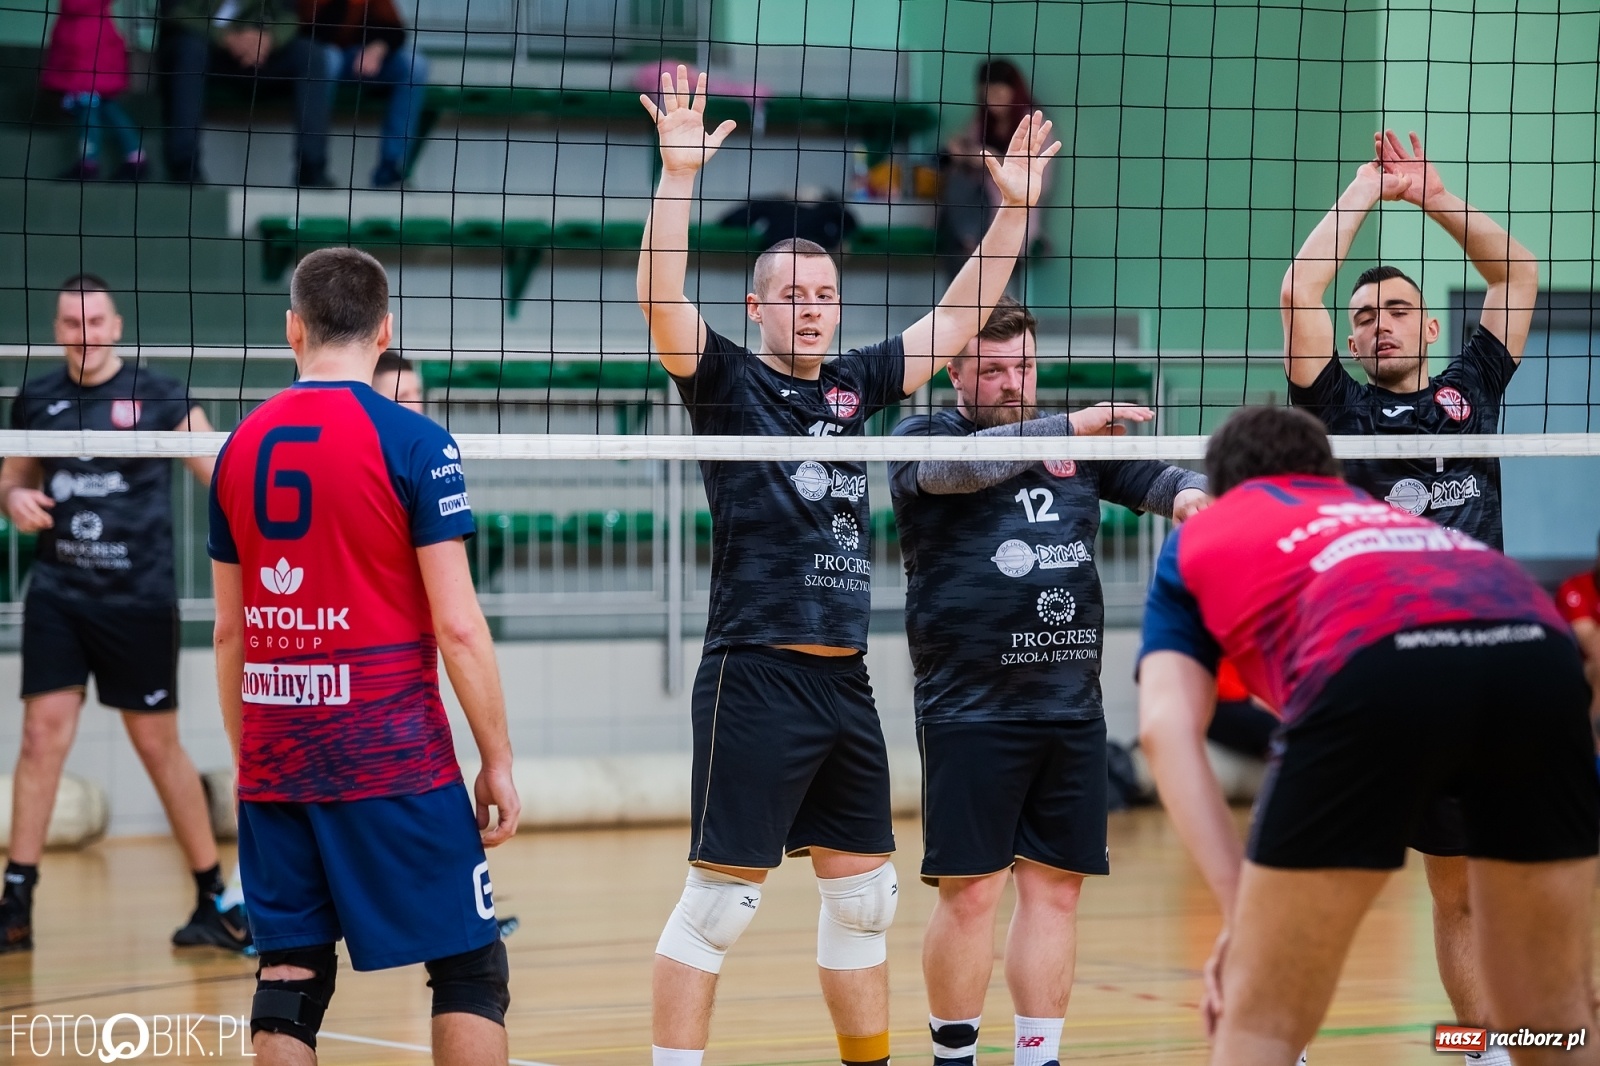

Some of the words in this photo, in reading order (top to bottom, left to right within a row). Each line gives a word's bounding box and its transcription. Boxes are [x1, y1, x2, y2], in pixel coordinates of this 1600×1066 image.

[254, 425, 323, 540] 6
[1430, 474, 1480, 505] DYMEL
[440, 493, 469, 513] nowi
[1014, 487, 1060, 523] 12
[1035, 540, 1091, 565] DYMEL
[813, 553, 871, 576] PROGRES
[804, 574, 846, 588] SZKOŁA
[249, 635, 322, 650] GROUP
[1011, 628, 1097, 648] PROGRESS
[1000, 650, 1049, 666] SZKOŁA
[1050, 648, 1098, 663] JĘZYKOWA
